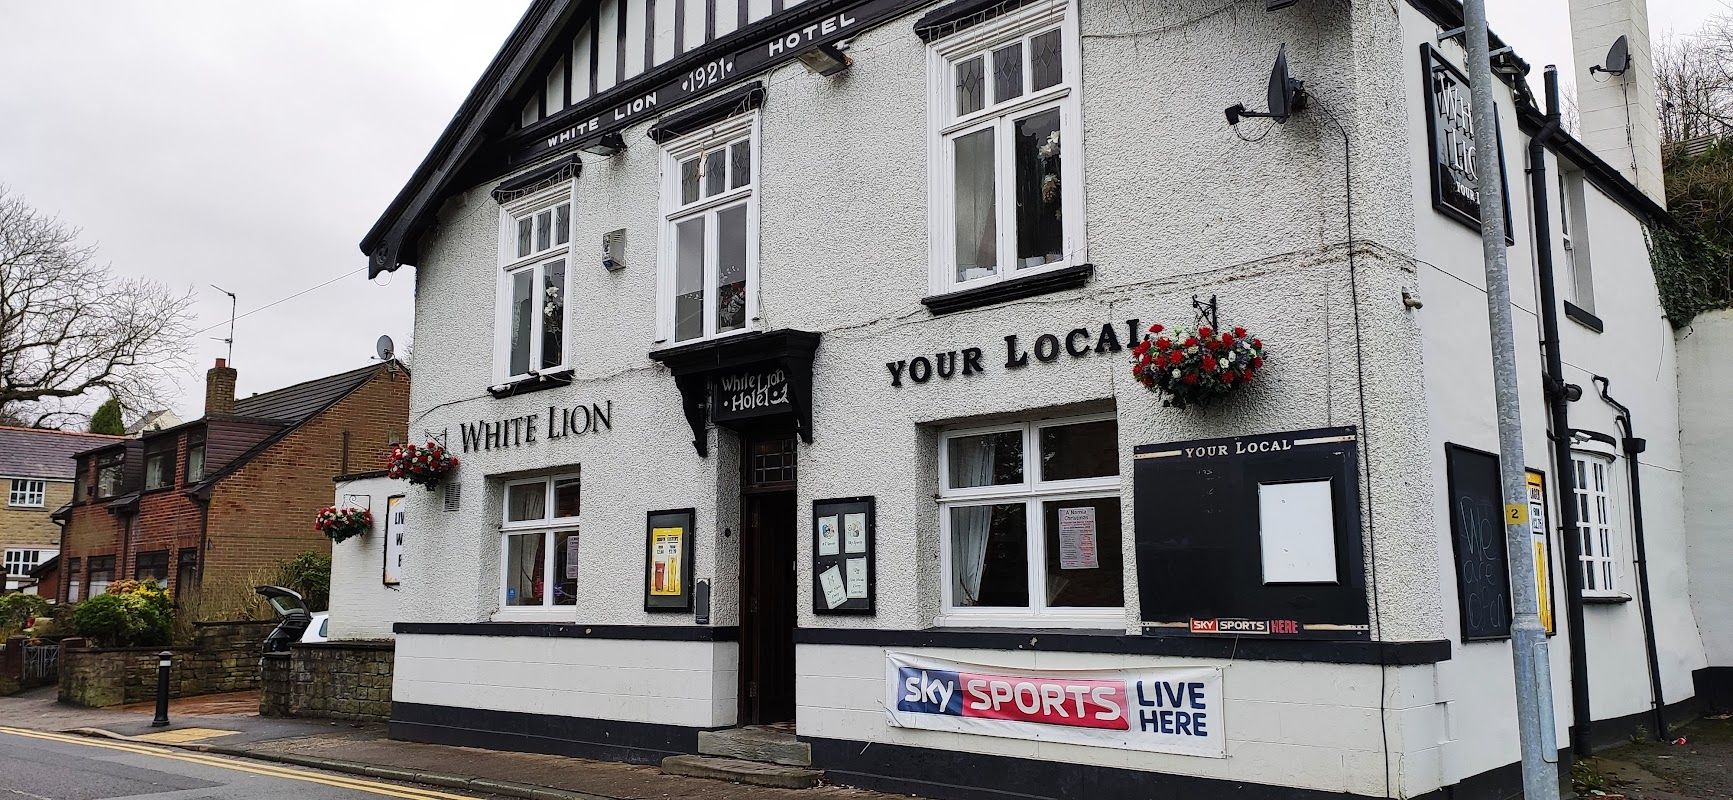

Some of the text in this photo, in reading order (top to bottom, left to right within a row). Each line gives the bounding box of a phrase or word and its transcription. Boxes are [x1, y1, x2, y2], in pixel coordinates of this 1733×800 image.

[547, 13, 856, 148] WHITE LION 1921 HOTEL
[1456, 181, 1475, 201] YOUR
[886, 318, 1150, 388] YOUR LOCAL
[460, 400, 612, 454] WHITE LION
[1185, 439, 1292, 459] YOUR LOCAL
[395, 512, 404, 525] LIV
[1511, 509, 1519, 519] 2
[1193, 619, 1298, 634] SKY SPORTS HERE
[904, 670, 1122, 721] sky SPORTS
[1136, 680, 1206, 710] LIVE
[1139, 710, 1208, 737] HERE
